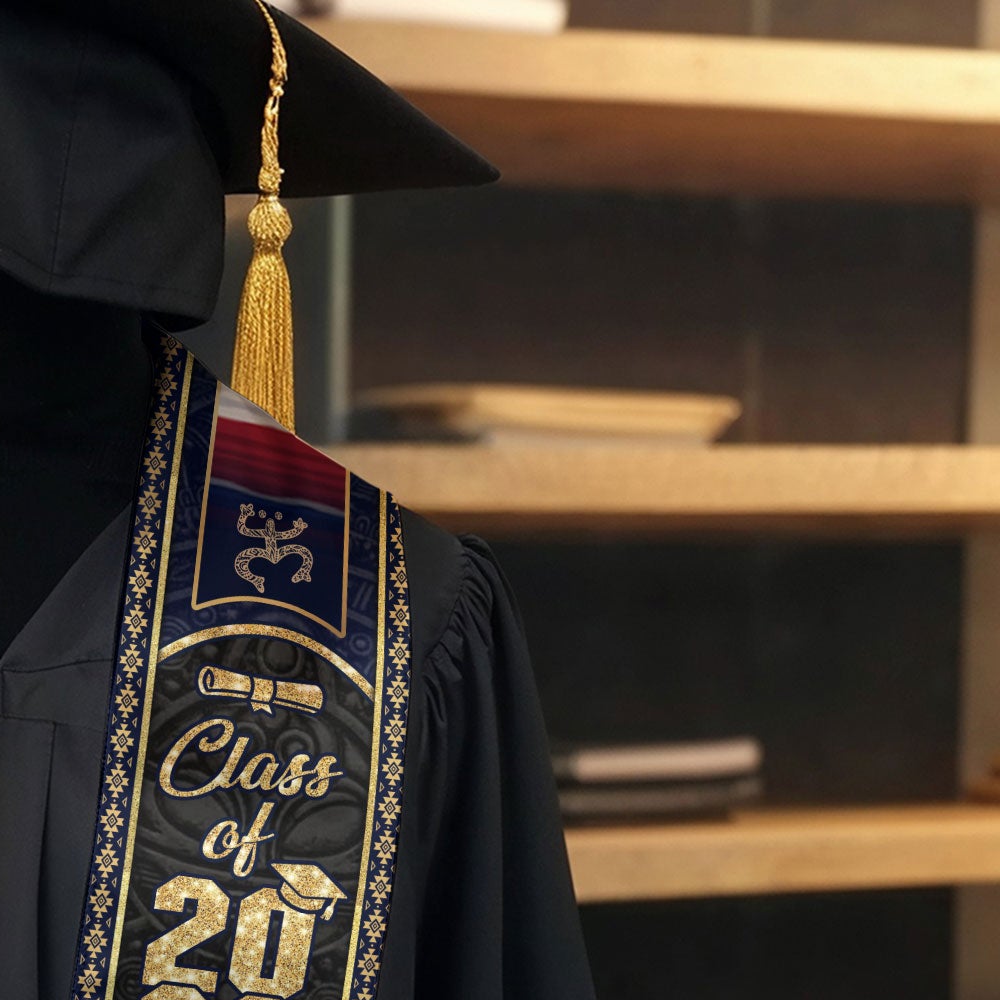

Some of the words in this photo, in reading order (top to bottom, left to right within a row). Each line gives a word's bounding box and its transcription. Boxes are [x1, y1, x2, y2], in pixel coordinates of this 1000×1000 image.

[159, 718, 343, 797] Class
[202, 802, 275, 877] of
[142, 874, 317, 999] 20
